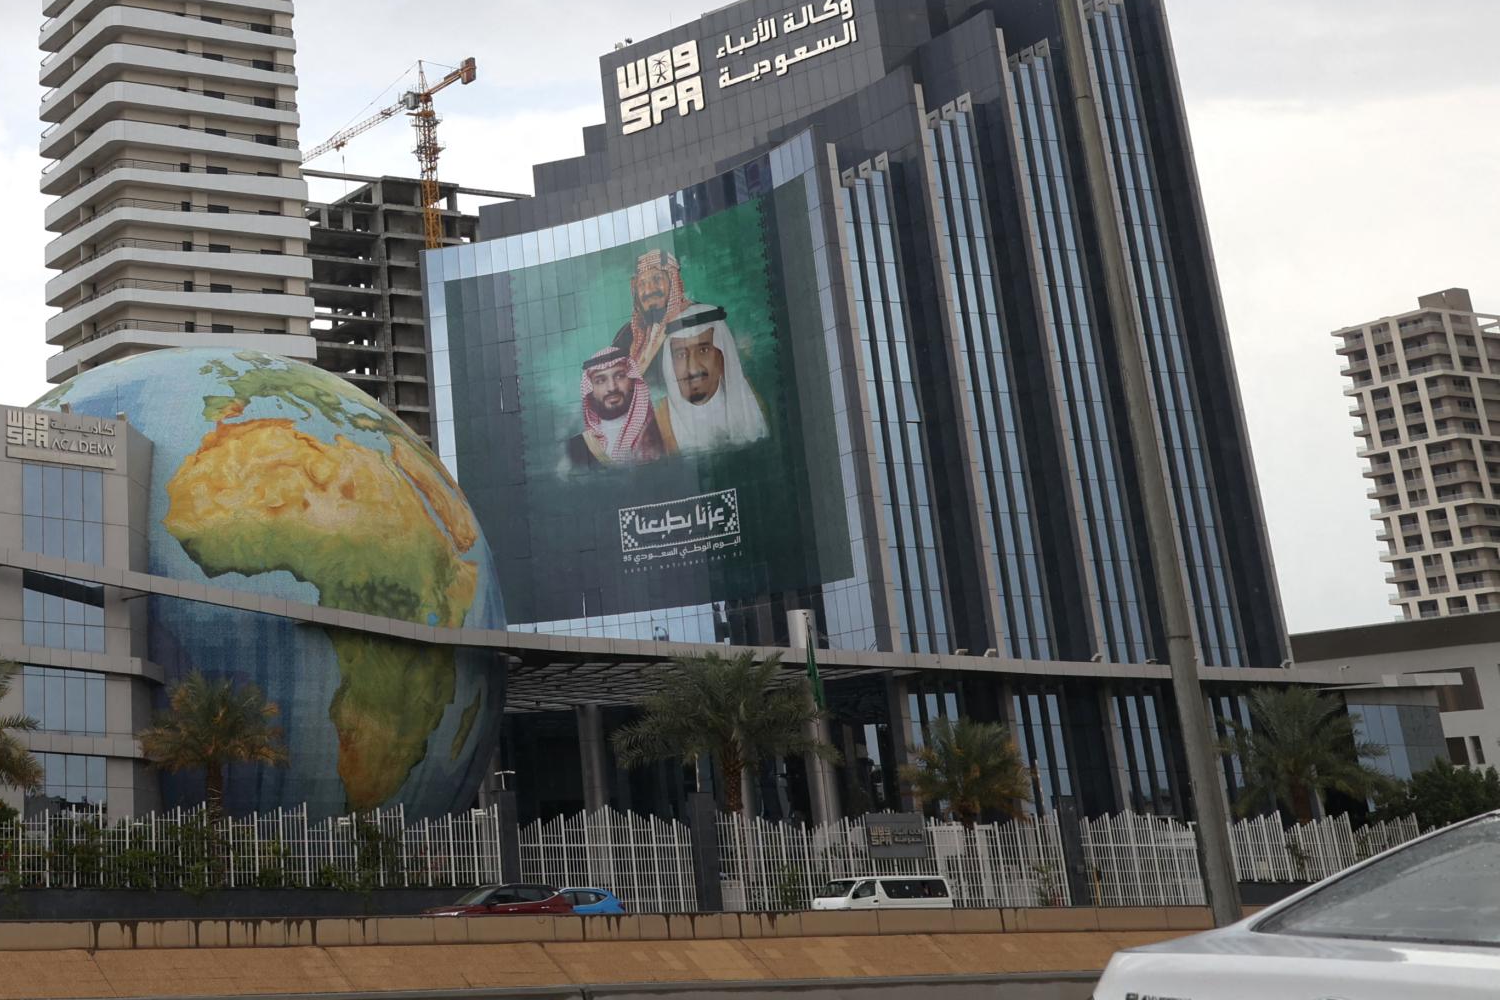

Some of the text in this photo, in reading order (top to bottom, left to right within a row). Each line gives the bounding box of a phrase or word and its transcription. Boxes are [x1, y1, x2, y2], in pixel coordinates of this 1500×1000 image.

[716, 17, 777, 59] الأنباء
[719, 20, 858, 89] السعودية
[620, 76, 704, 135] SPA
[6, 426, 49, 448] SPA
[52, 438, 117, 457] ACADEMY
[679, 541, 712, 558] الوطني
[712, 536, 741, 549] اليوم
[633, 548, 678, 564] السعودي
